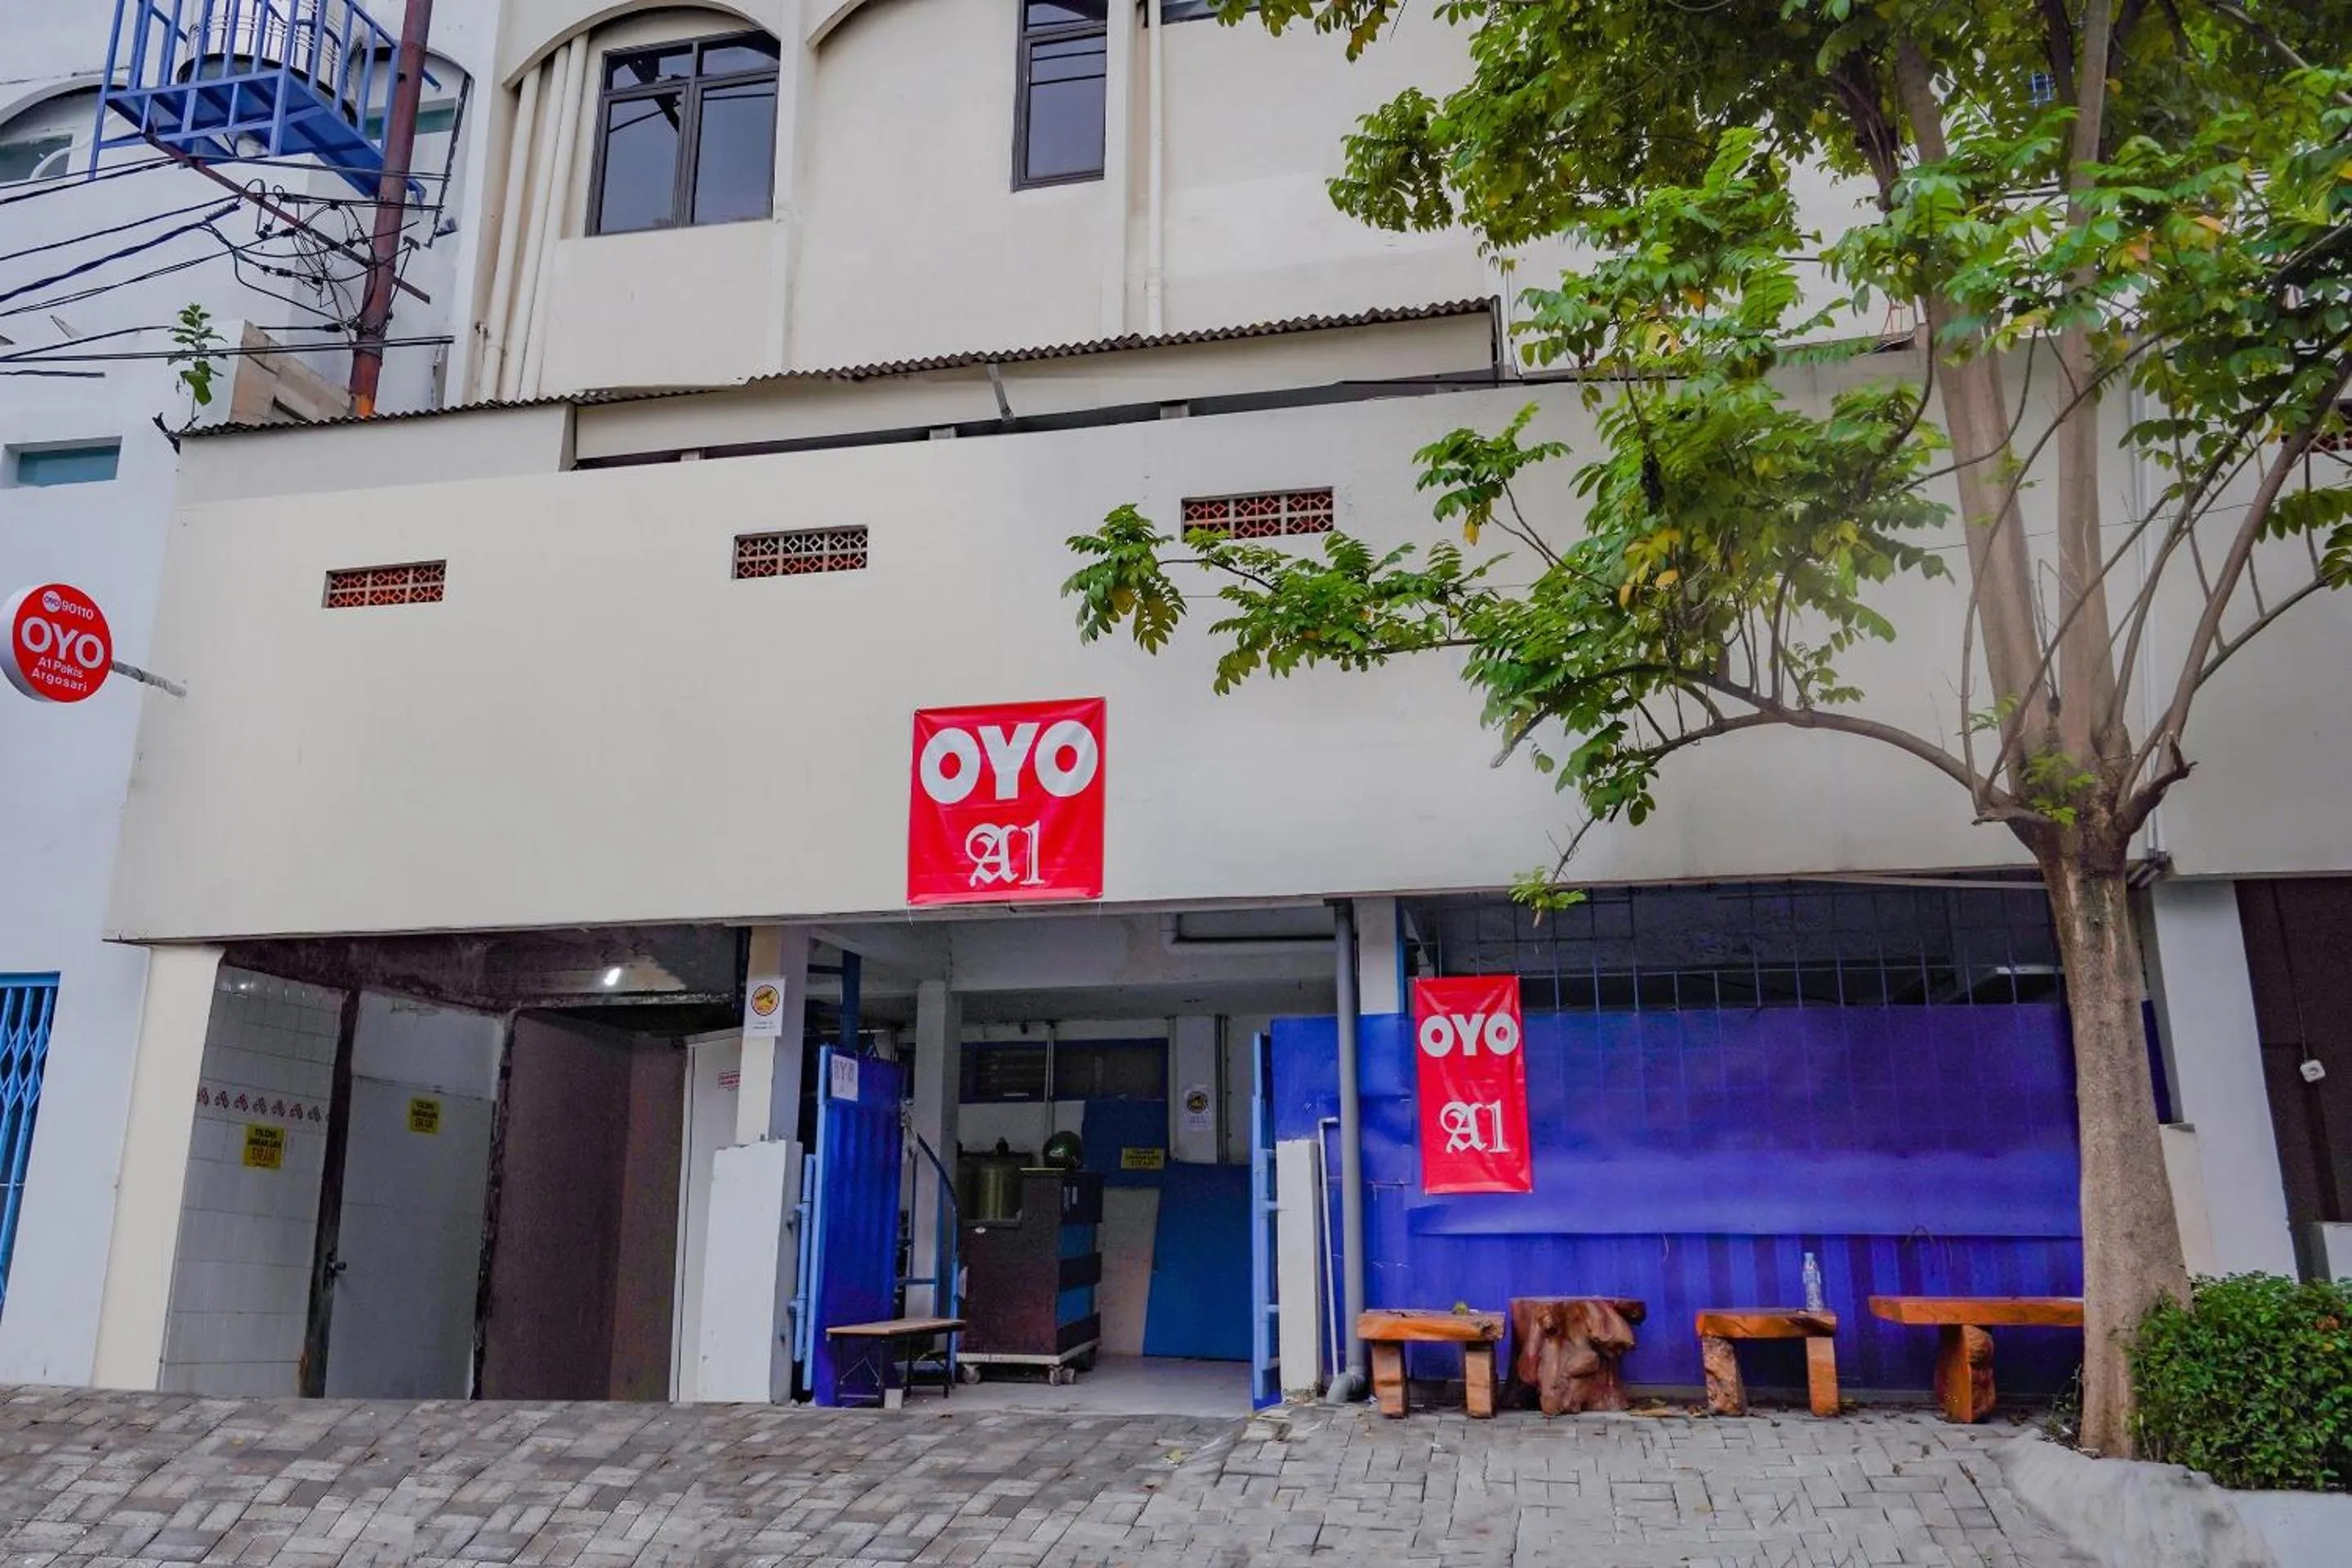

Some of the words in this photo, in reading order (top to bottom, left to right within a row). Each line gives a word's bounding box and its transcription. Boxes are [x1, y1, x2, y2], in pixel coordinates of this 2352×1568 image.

[62, 600, 94, 621] 90110
[21, 617, 104, 669] OYO
[31, 667, 87, 692] Argosari
[53, 660, 83, 678] Pakis
[920, 719, 1098, 804] OYO
[1419, 1013, 1520, 1058] OYO
